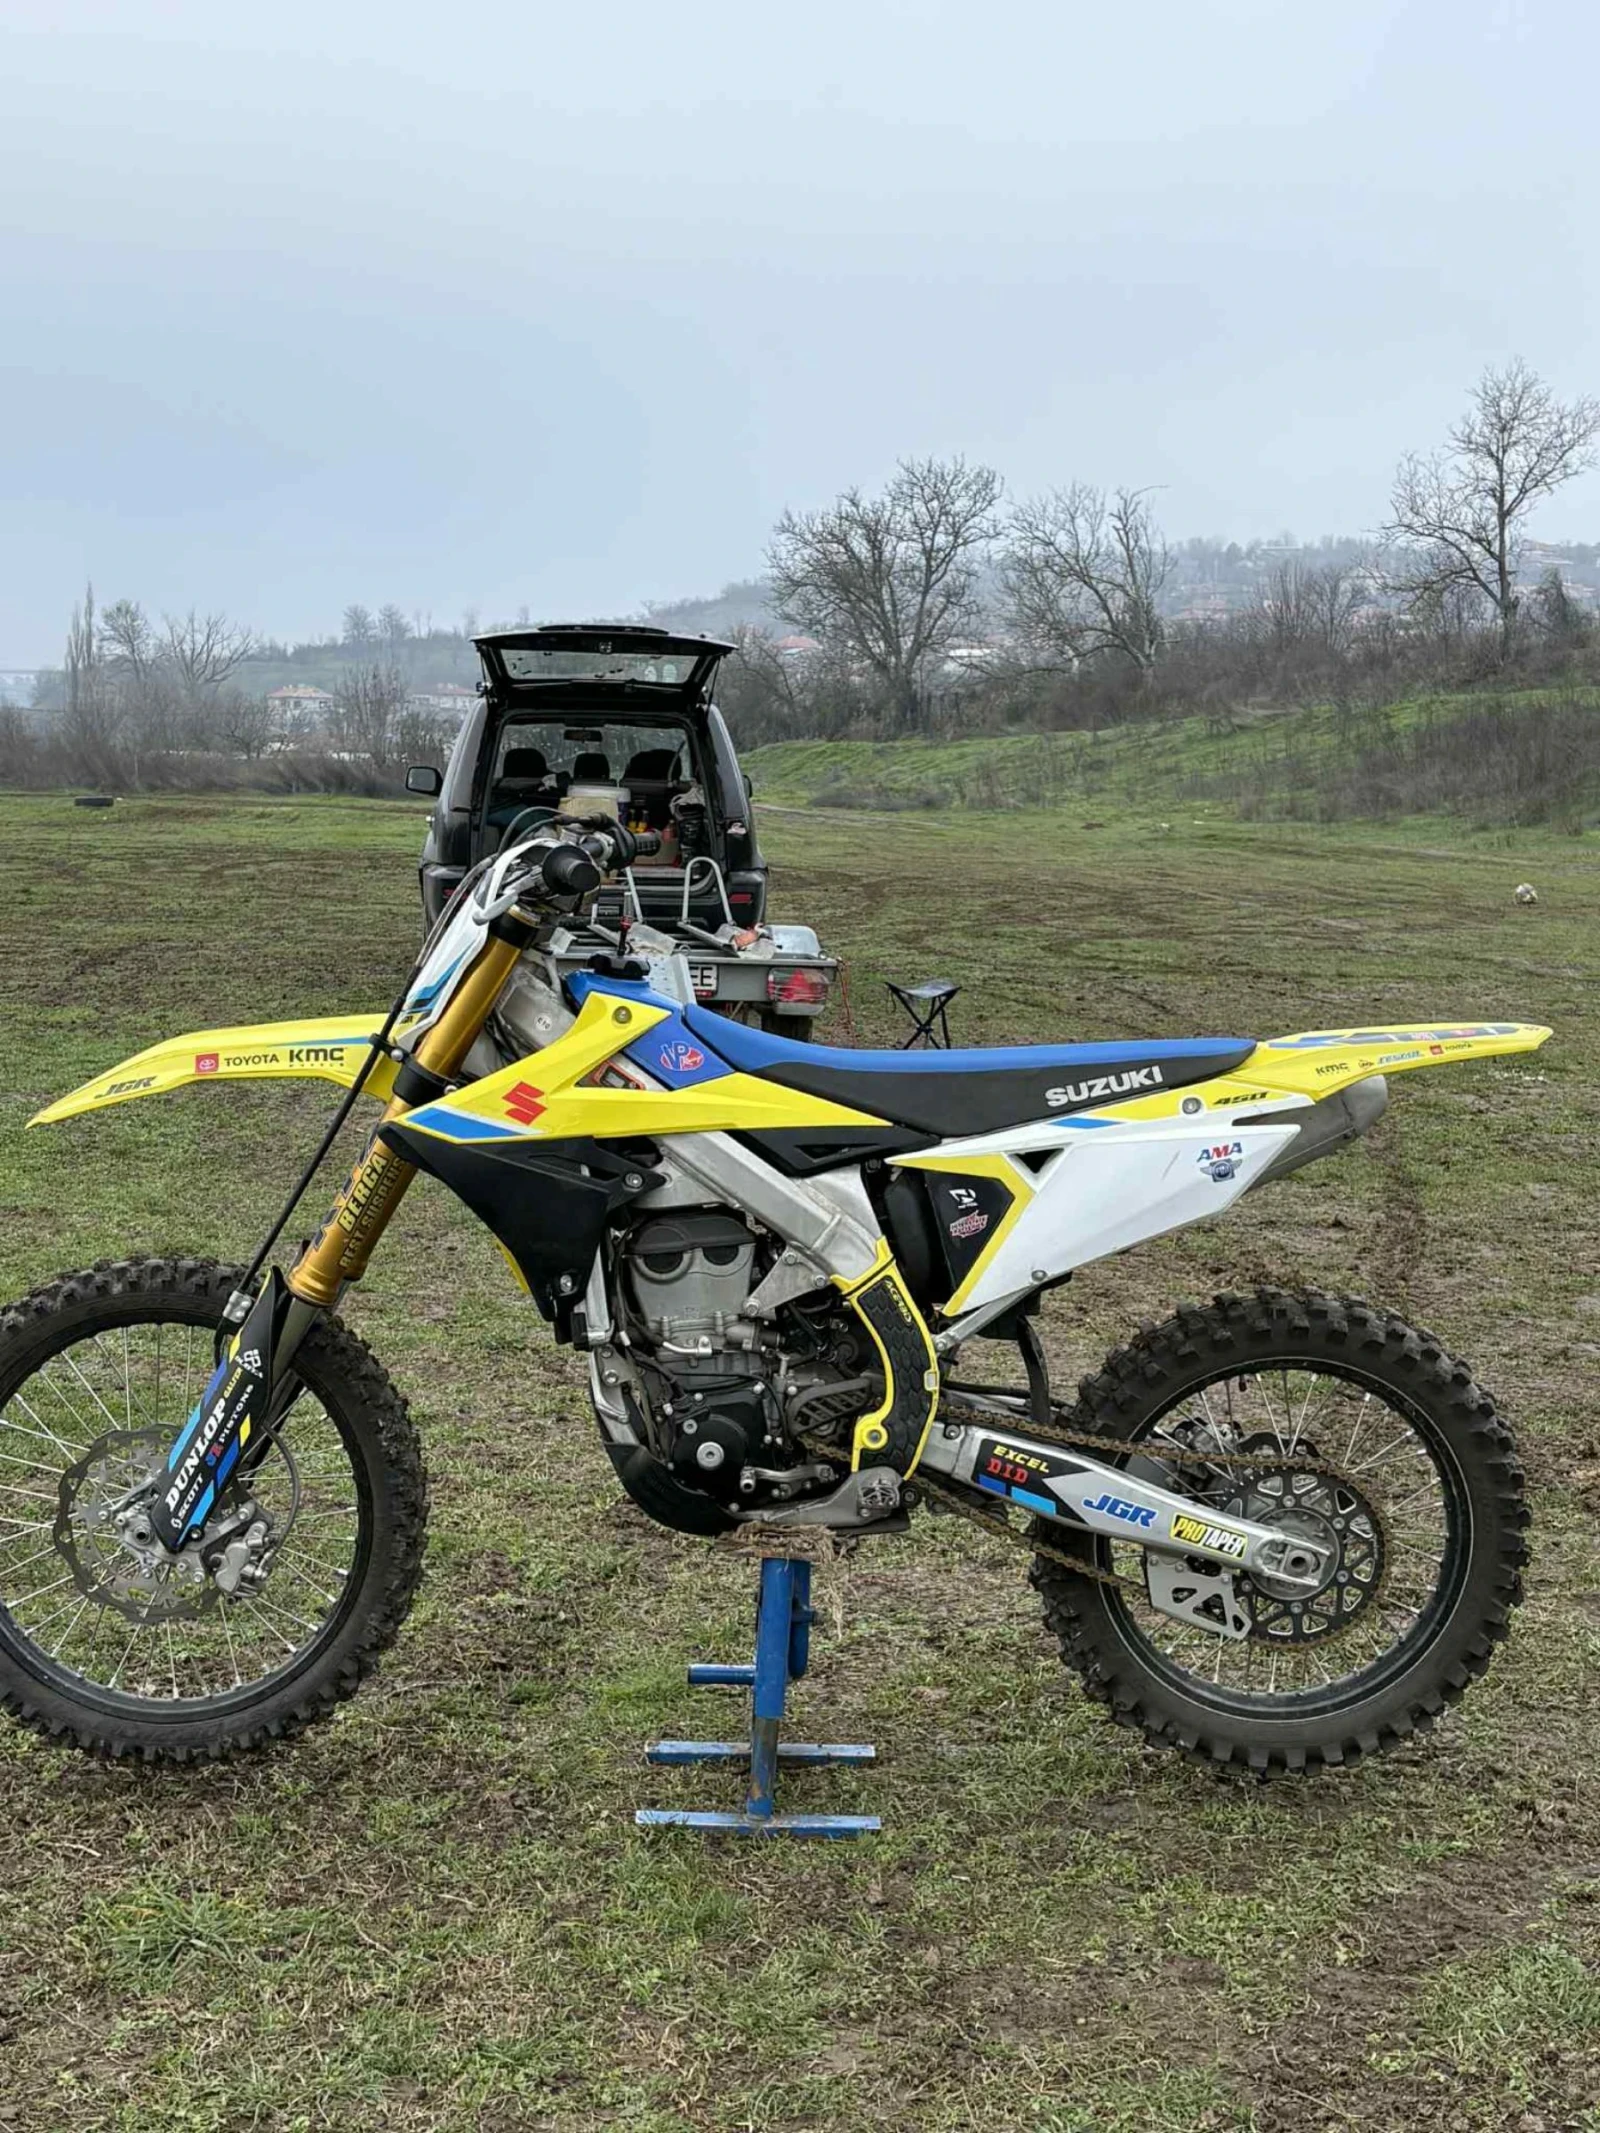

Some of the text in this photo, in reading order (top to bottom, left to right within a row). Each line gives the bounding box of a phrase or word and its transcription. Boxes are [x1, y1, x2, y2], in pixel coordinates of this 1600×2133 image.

[224, 1053, 279, 1067] TOYOTA
[94, 1076, 157, 1099] JGR
[1045, 1065, 1164, 1107] SUZUKI
[1213, 1091, 1269, 1105] 450
[1197, 1142, 1242, 1163] AMA
[338, 1152, 389, 1232] BERGA
[339, 1229, 365, 1269] BEST
[218, 1384, 254, 1444] PISTONS
[165, 1398, 226, 1512] DUNLOP
[993, 1445, 1050, 1473] EXCEL
[178, 1473, 204, 1520] SCOTT
[1082, 1492, 1157, 1528] JGR
